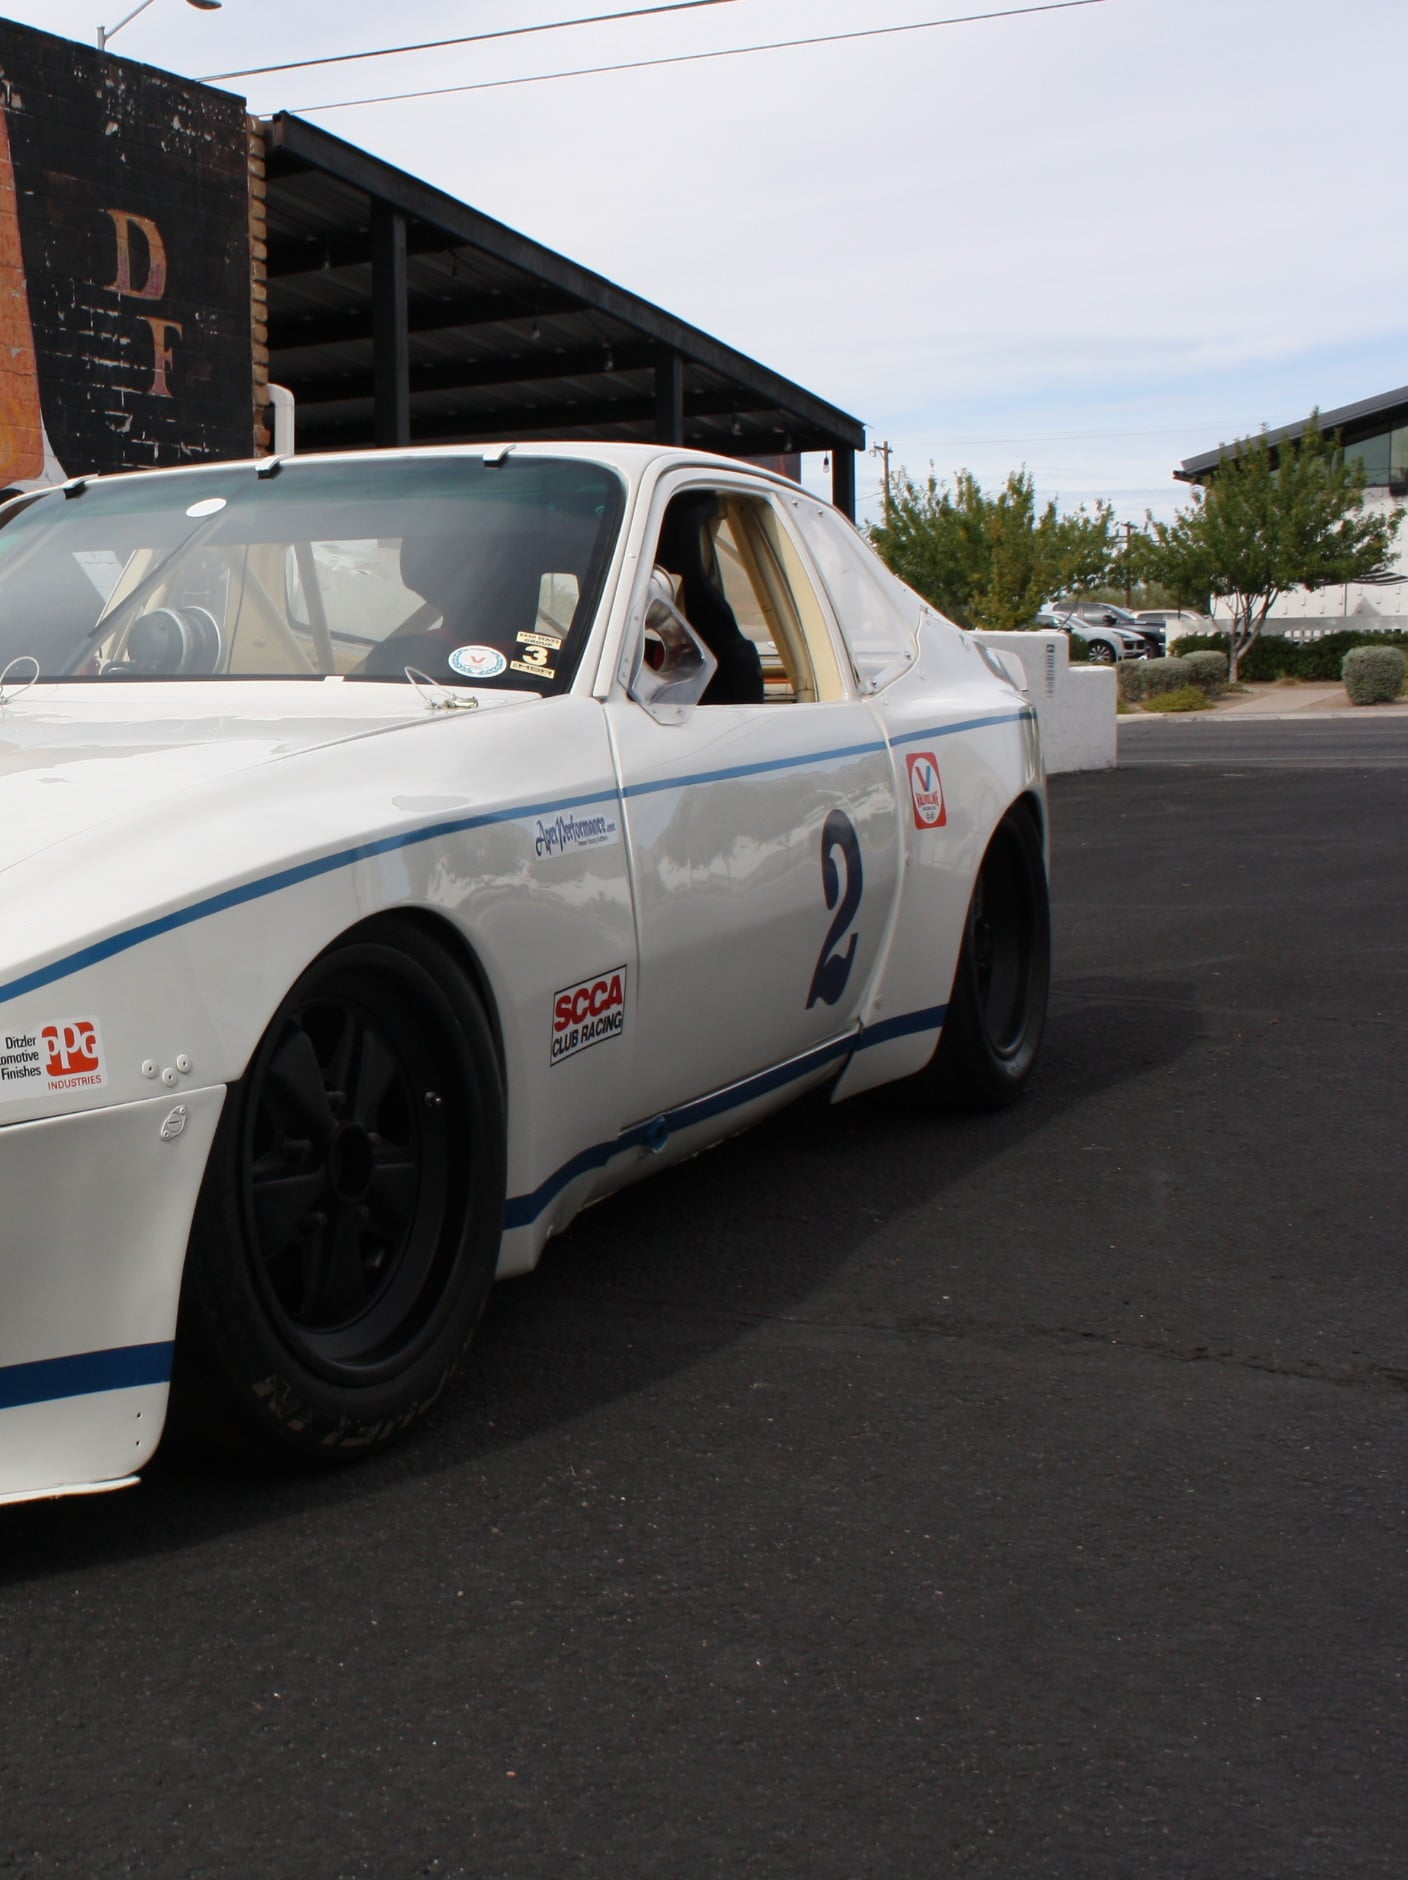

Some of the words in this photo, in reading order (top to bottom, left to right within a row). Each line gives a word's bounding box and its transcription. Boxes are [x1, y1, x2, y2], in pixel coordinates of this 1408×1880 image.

[102, 208, 167, 300] D
[137, 315, 183, 398] F
[522, 645, 548, 666] 3
[805, 808, 864, 1010] 2
[553, 974, 623, 1033] SCCA
[4, 1035, 37, 1051] Ditzler
[552, 1029, 579, 1058] CLUB
[580, 1010, 623, 1044] RACING
[0, 1065, 42, 1081] Finishes
[47, 1074, 103, 1092] INDUSTRIES
